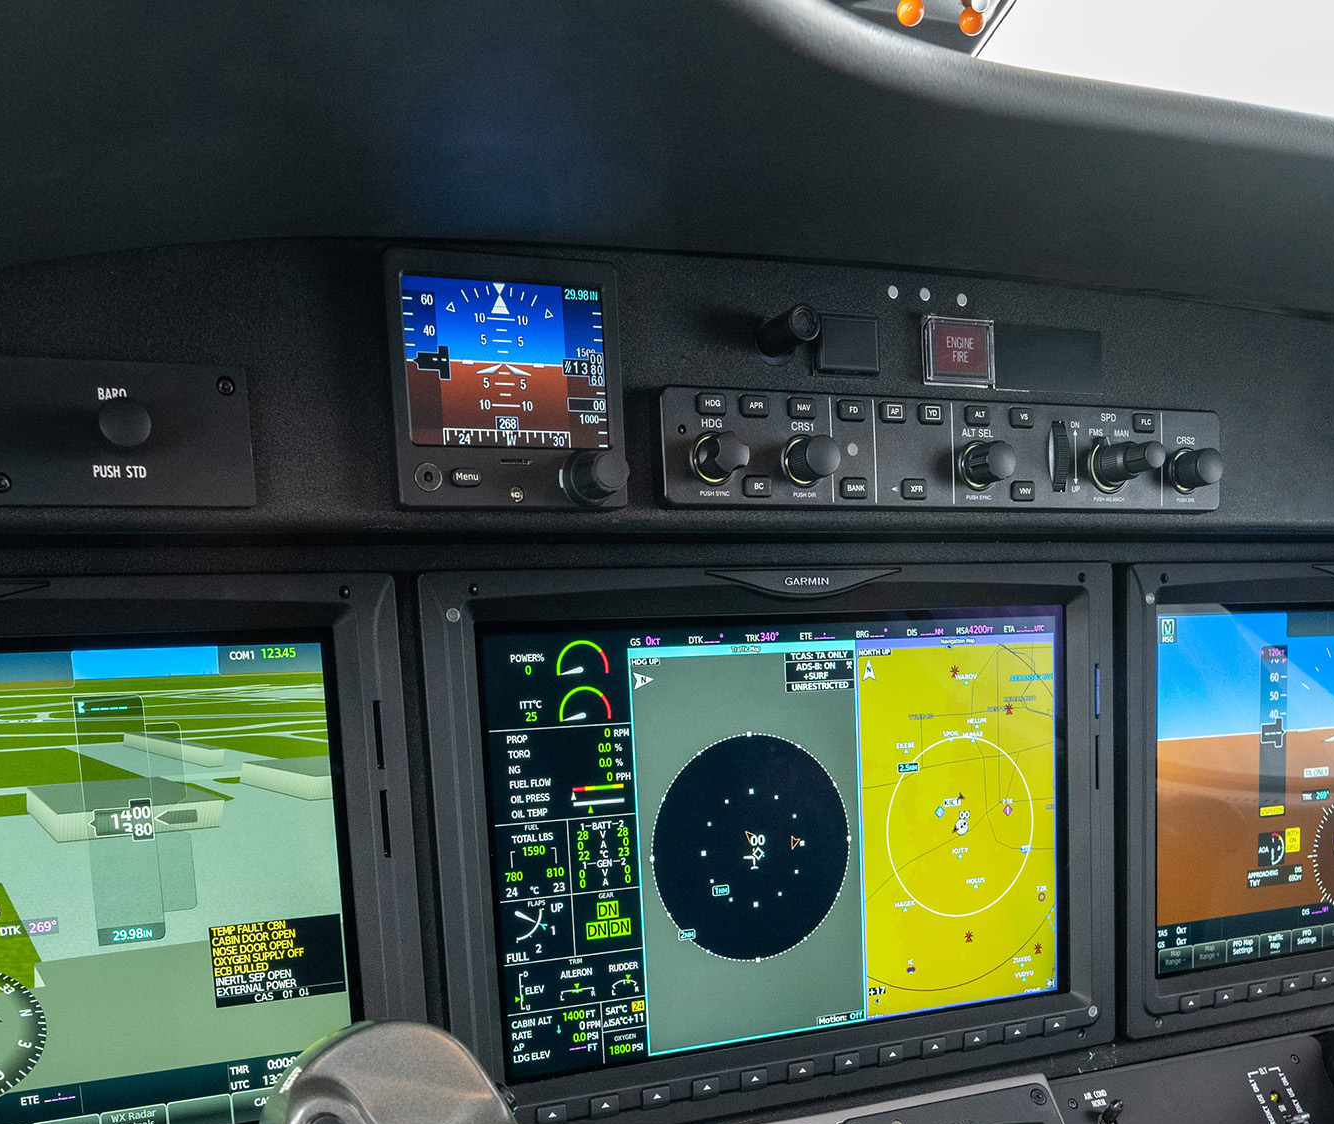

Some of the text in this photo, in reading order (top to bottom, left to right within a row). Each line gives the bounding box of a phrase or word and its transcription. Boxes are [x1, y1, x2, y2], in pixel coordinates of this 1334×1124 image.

[946, 336, 974, 351] ENGINE
[952, 350, 969, 364] FIRE
[1100, 413, 1117, 423] SPD
[701, 418, 722, 429] HDG
[791, 422, 815, 431] CRS1
[962, 429, 994, 438] ALT SEL
[1176, 436, 1195, 445] CRS2
[92, 465, 147, 479] PUSH STD
[455, 472, 479, 482] Menu
[847, 484, 865, 492] BANK
[784, 576, 829, 586] GARMIN
[229, 647, 296, 661] COM1 123.45
[791, 681, 849, 691] UNRESTRICTED
[507, 735, 528, 744] PROP
[508, 750, 530, 759] TORQ
[509, 778, 551, 789] FUEL FLOW
[511, 832, 553, 844] TOTAL LBS
[608, 962, 639, 973] RUDDER
[560, 967, 593, 979] AILERON
[511, 1015, 552, 1029] CABIN ALT
